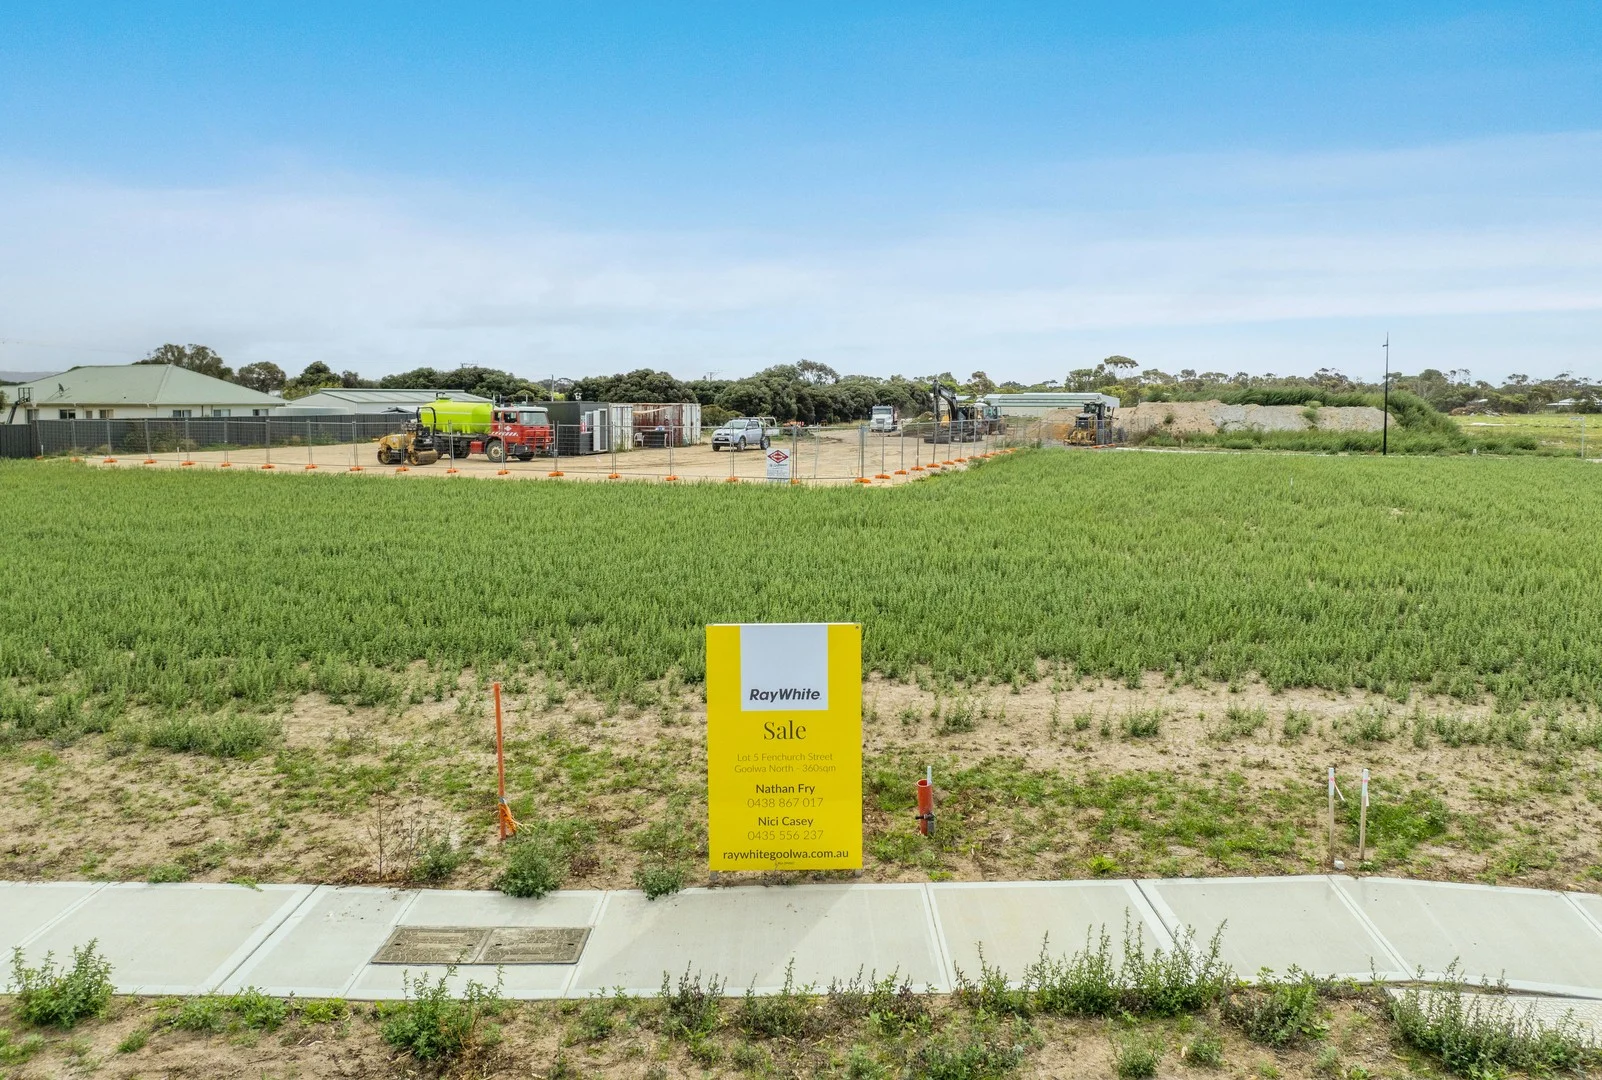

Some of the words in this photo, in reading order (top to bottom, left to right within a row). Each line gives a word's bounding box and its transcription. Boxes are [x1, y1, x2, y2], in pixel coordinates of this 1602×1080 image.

[764, 720, 806, 740] Sale
[737, 753, 751, 762] Lot
[753, 753, 759, 761] 5
[762, 753, 806, 761] Fenchurch
[808, 753, 833, 761] Street
[734, 764, 766, 773] Goolwa
[769, 764, 794, 772] North
[802, 764, 836, 774] 360sqm
[756, 784, 795, 793] Nathan
[798, 784, 815, 795] Fry
[747, 798, 775, 808] 0438
[779, 798, 799, 808] 867
[802, 798, 824, 807] 017
[758, 816, 778, 826] Nici
[782, 816, 814, 828] Casey
[748, 830, 776, 840] 0435
[779, 830, 800, 840] 556
[803, 830, 824, 840] 237
[723, 849, 849, 860] raywhitegoolwa.com.au
